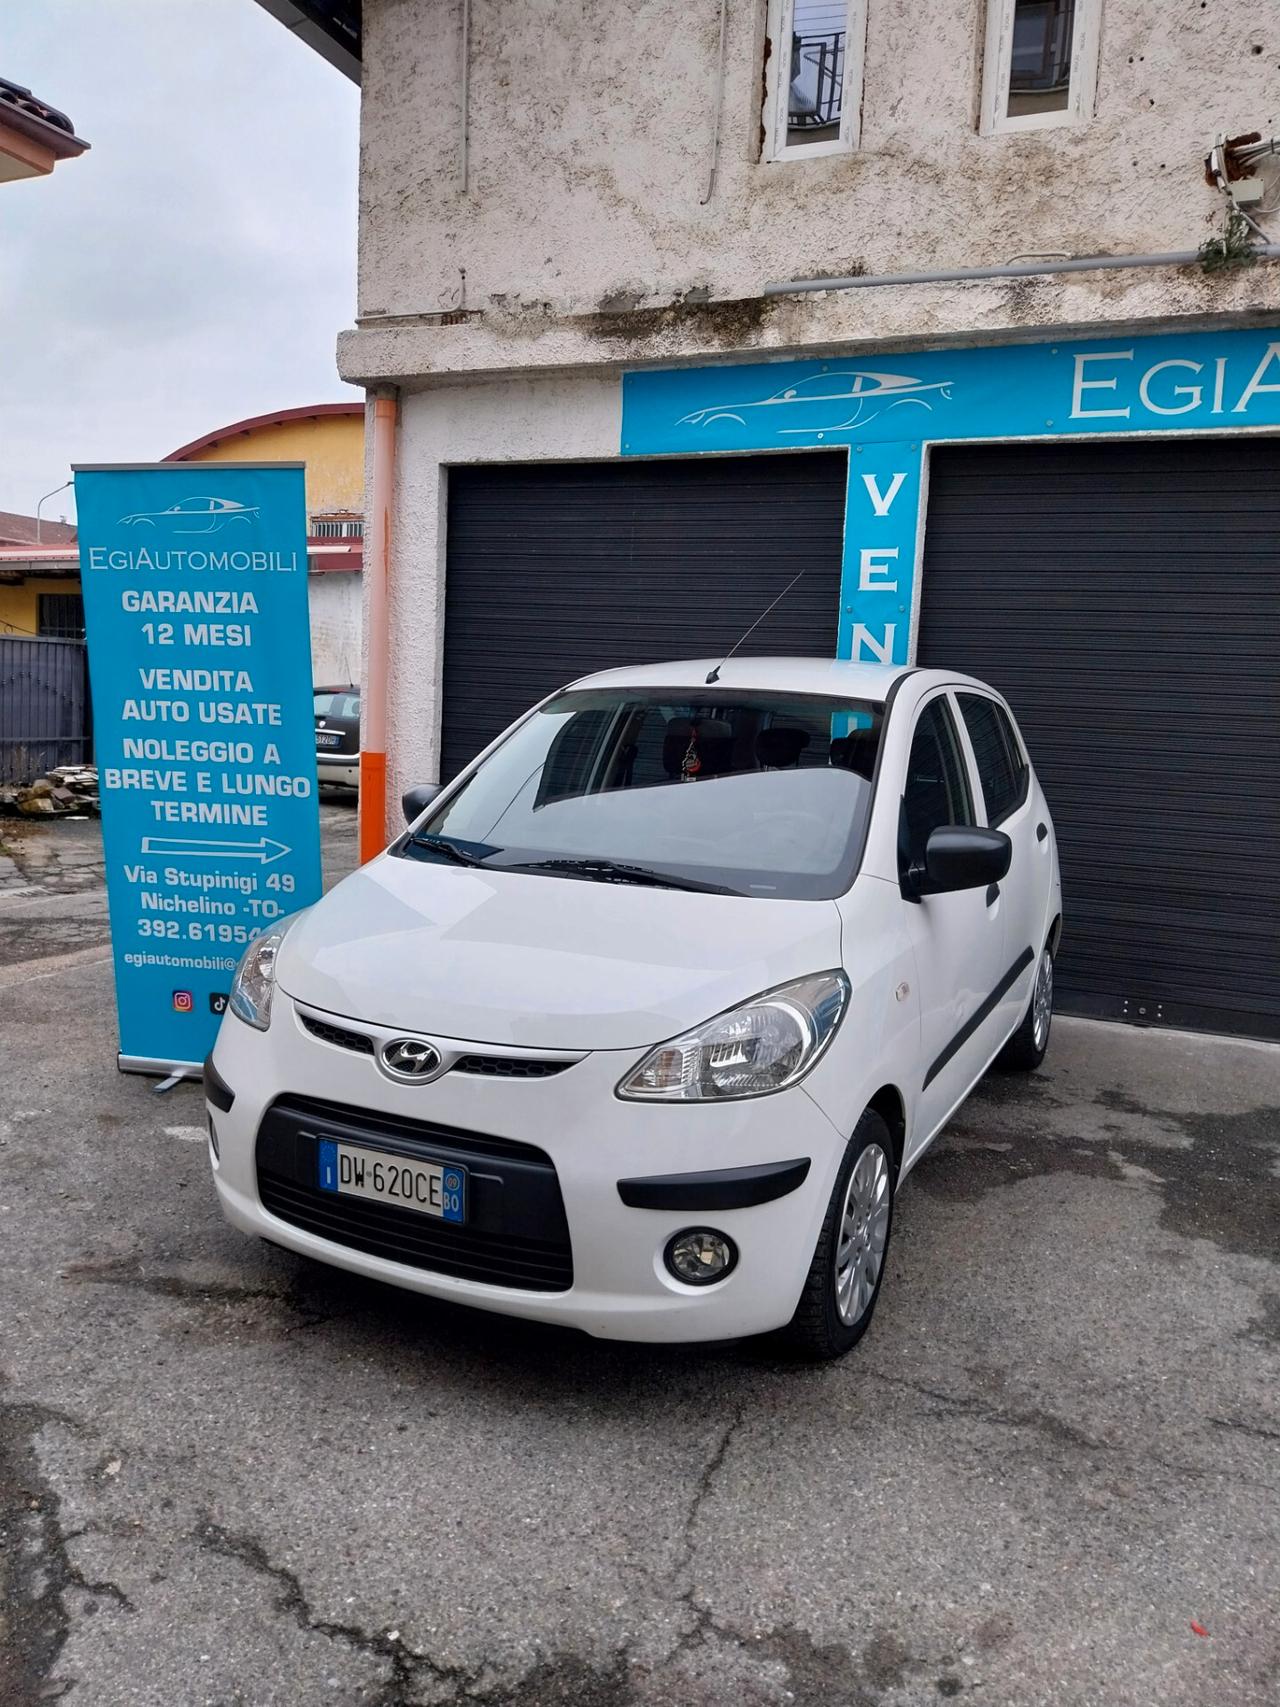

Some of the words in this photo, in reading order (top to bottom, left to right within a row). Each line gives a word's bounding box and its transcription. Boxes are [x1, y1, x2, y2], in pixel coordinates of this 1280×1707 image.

[121, 590, 259, 614] GARANZIA
[141, 623, 174, 645] 12
[184, 624, 251, 647] MESI
[139, 668, 254, 693] VENDITA
[121, 700, 190, 722] AUTO
[199, 702, 282, 725] USATE
[123, 738, 254, 764] NOLEGGIO
[263, 743, 281, 764] A
[105, 769, 187, 792] BREVE
[197, 772, 212, 793] E
[222, 774, 311, 798] LUNGO
[151, 801, 268, 826] TERMINE
[124, 865, 158, 884] Via
[165, 867, 258, 894] Stupinigi
[266, 874, 295, 892] 49
[141, 892, 236, 916] Nichelino
[243, 899, 285, 918] -TO-
[124, 952, 240, 971] egiautomobili@
